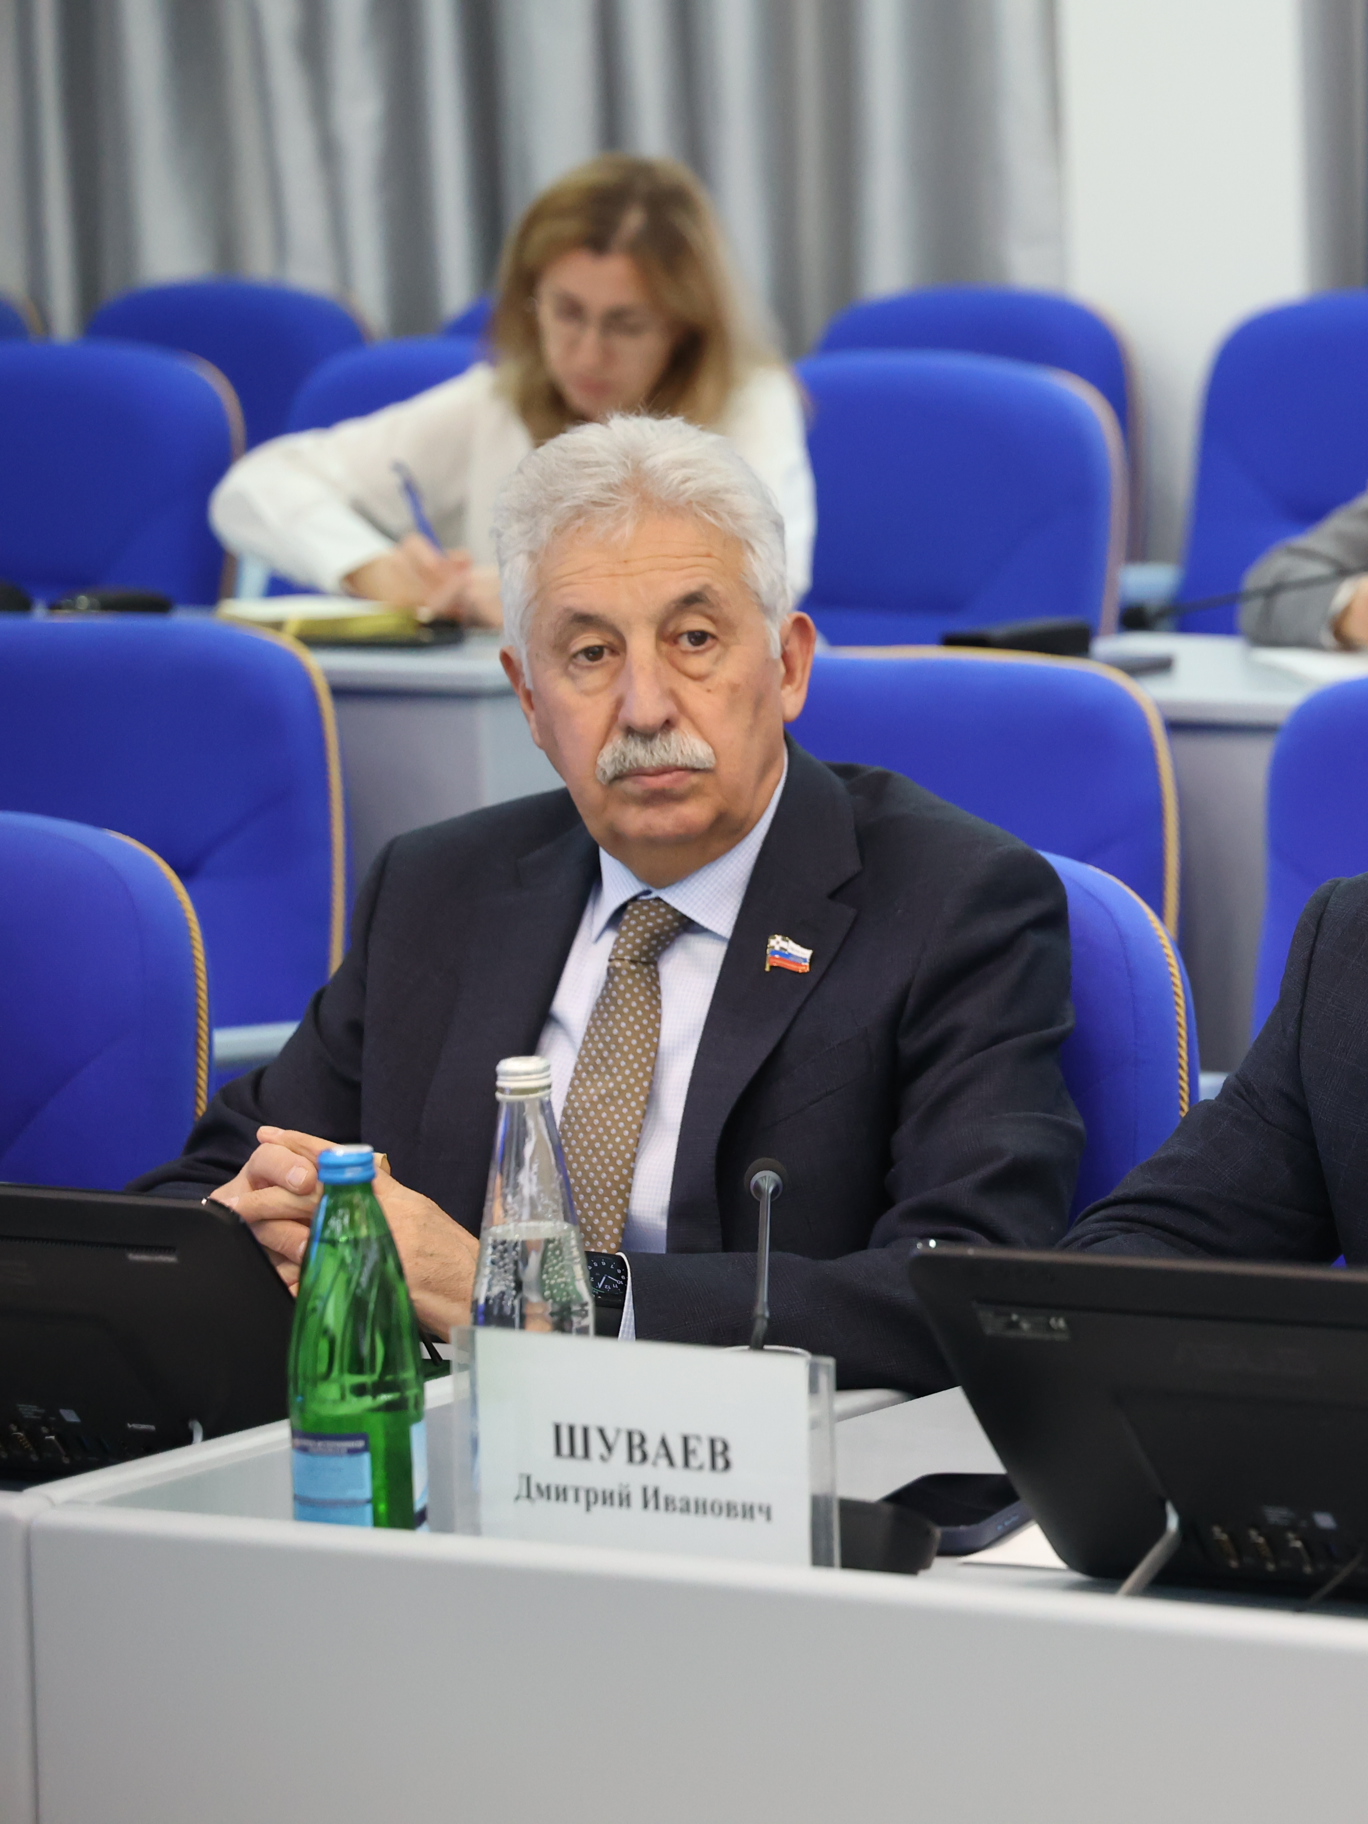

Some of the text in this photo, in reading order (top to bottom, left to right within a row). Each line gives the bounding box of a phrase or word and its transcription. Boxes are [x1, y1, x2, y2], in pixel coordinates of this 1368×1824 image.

[552, 1421, 734, 1474] ШУВАЕВ
[512, 1473, 773, 1523] Дмитрий Иванович
